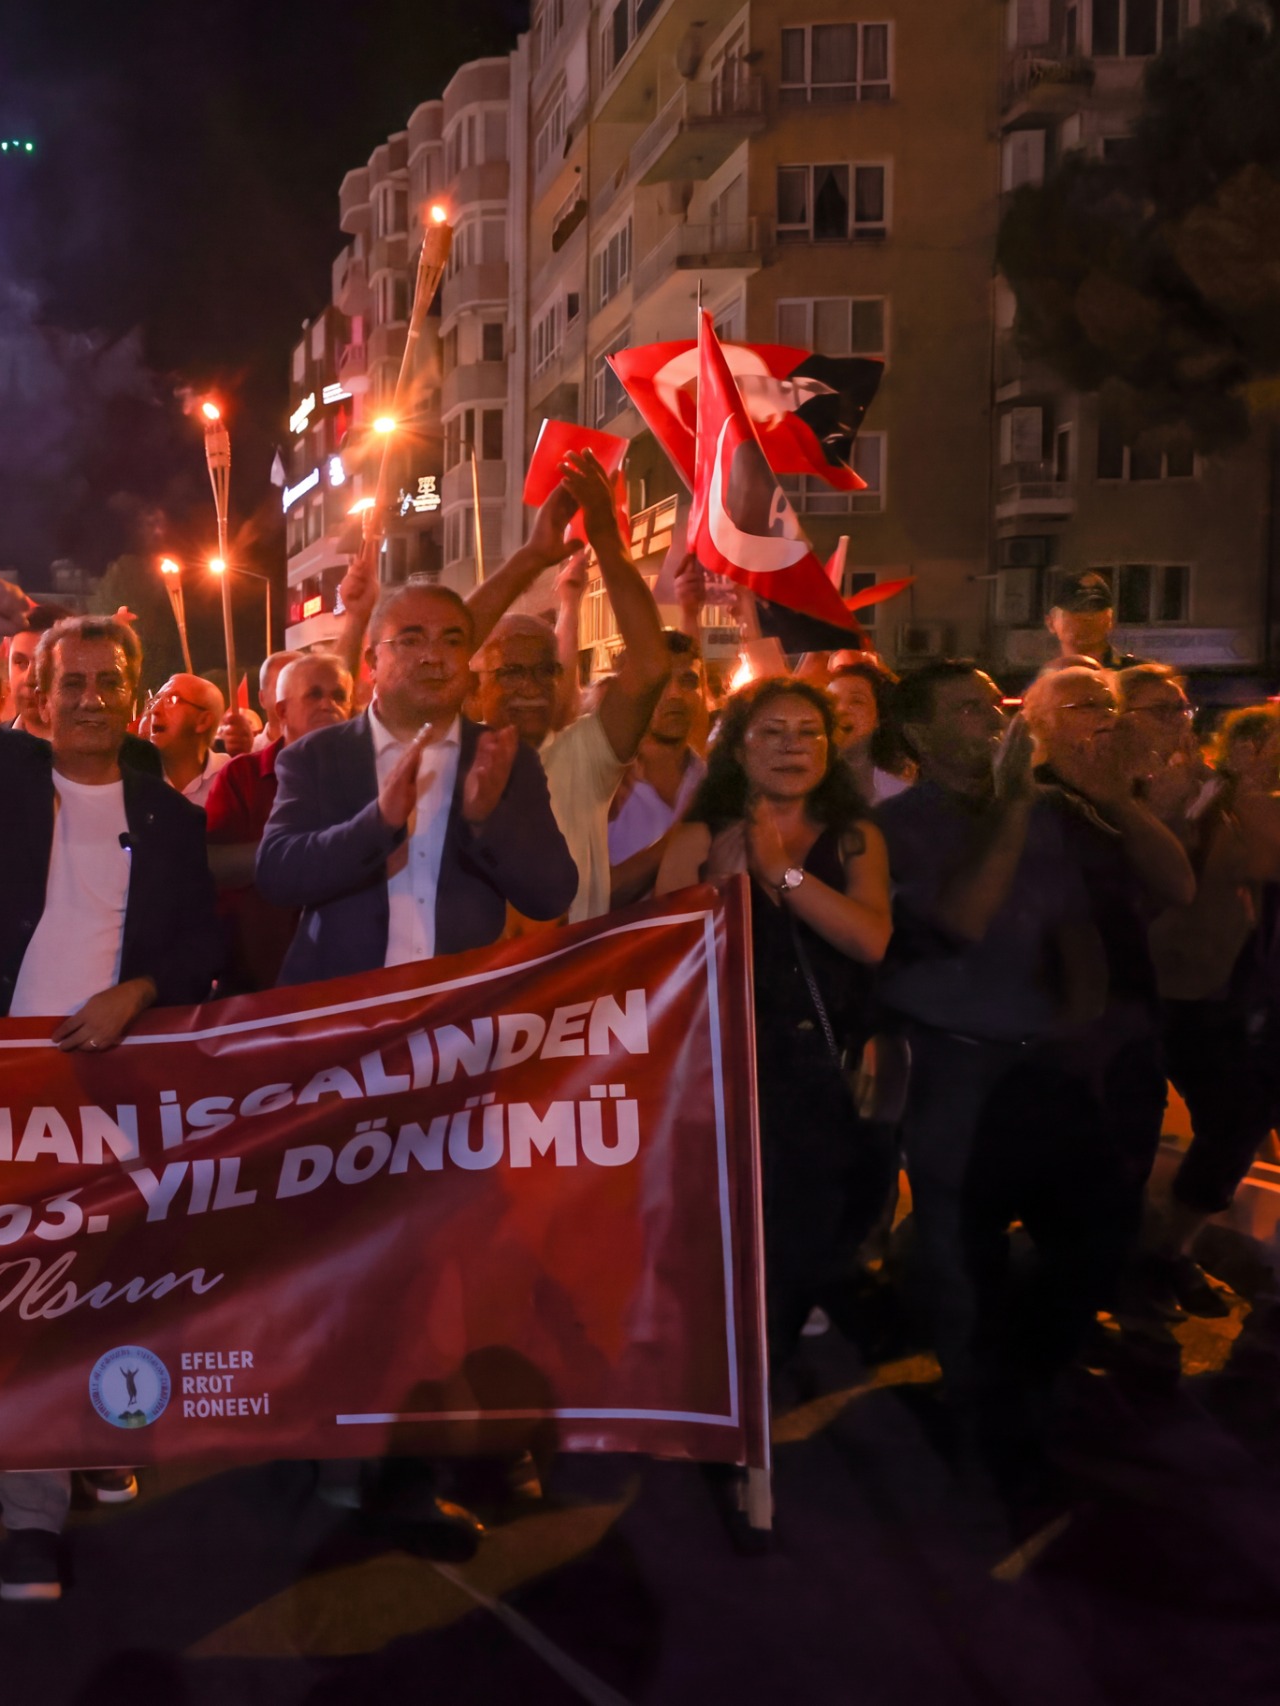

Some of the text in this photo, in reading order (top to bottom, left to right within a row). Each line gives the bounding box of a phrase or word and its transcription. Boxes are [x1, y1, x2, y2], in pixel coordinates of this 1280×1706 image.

[129, 1157, 257, 1222] YIL
[275, 1083, 640, 1199] DÖNÜMÜ
[181, 1351, 254, 1370] EFELER
